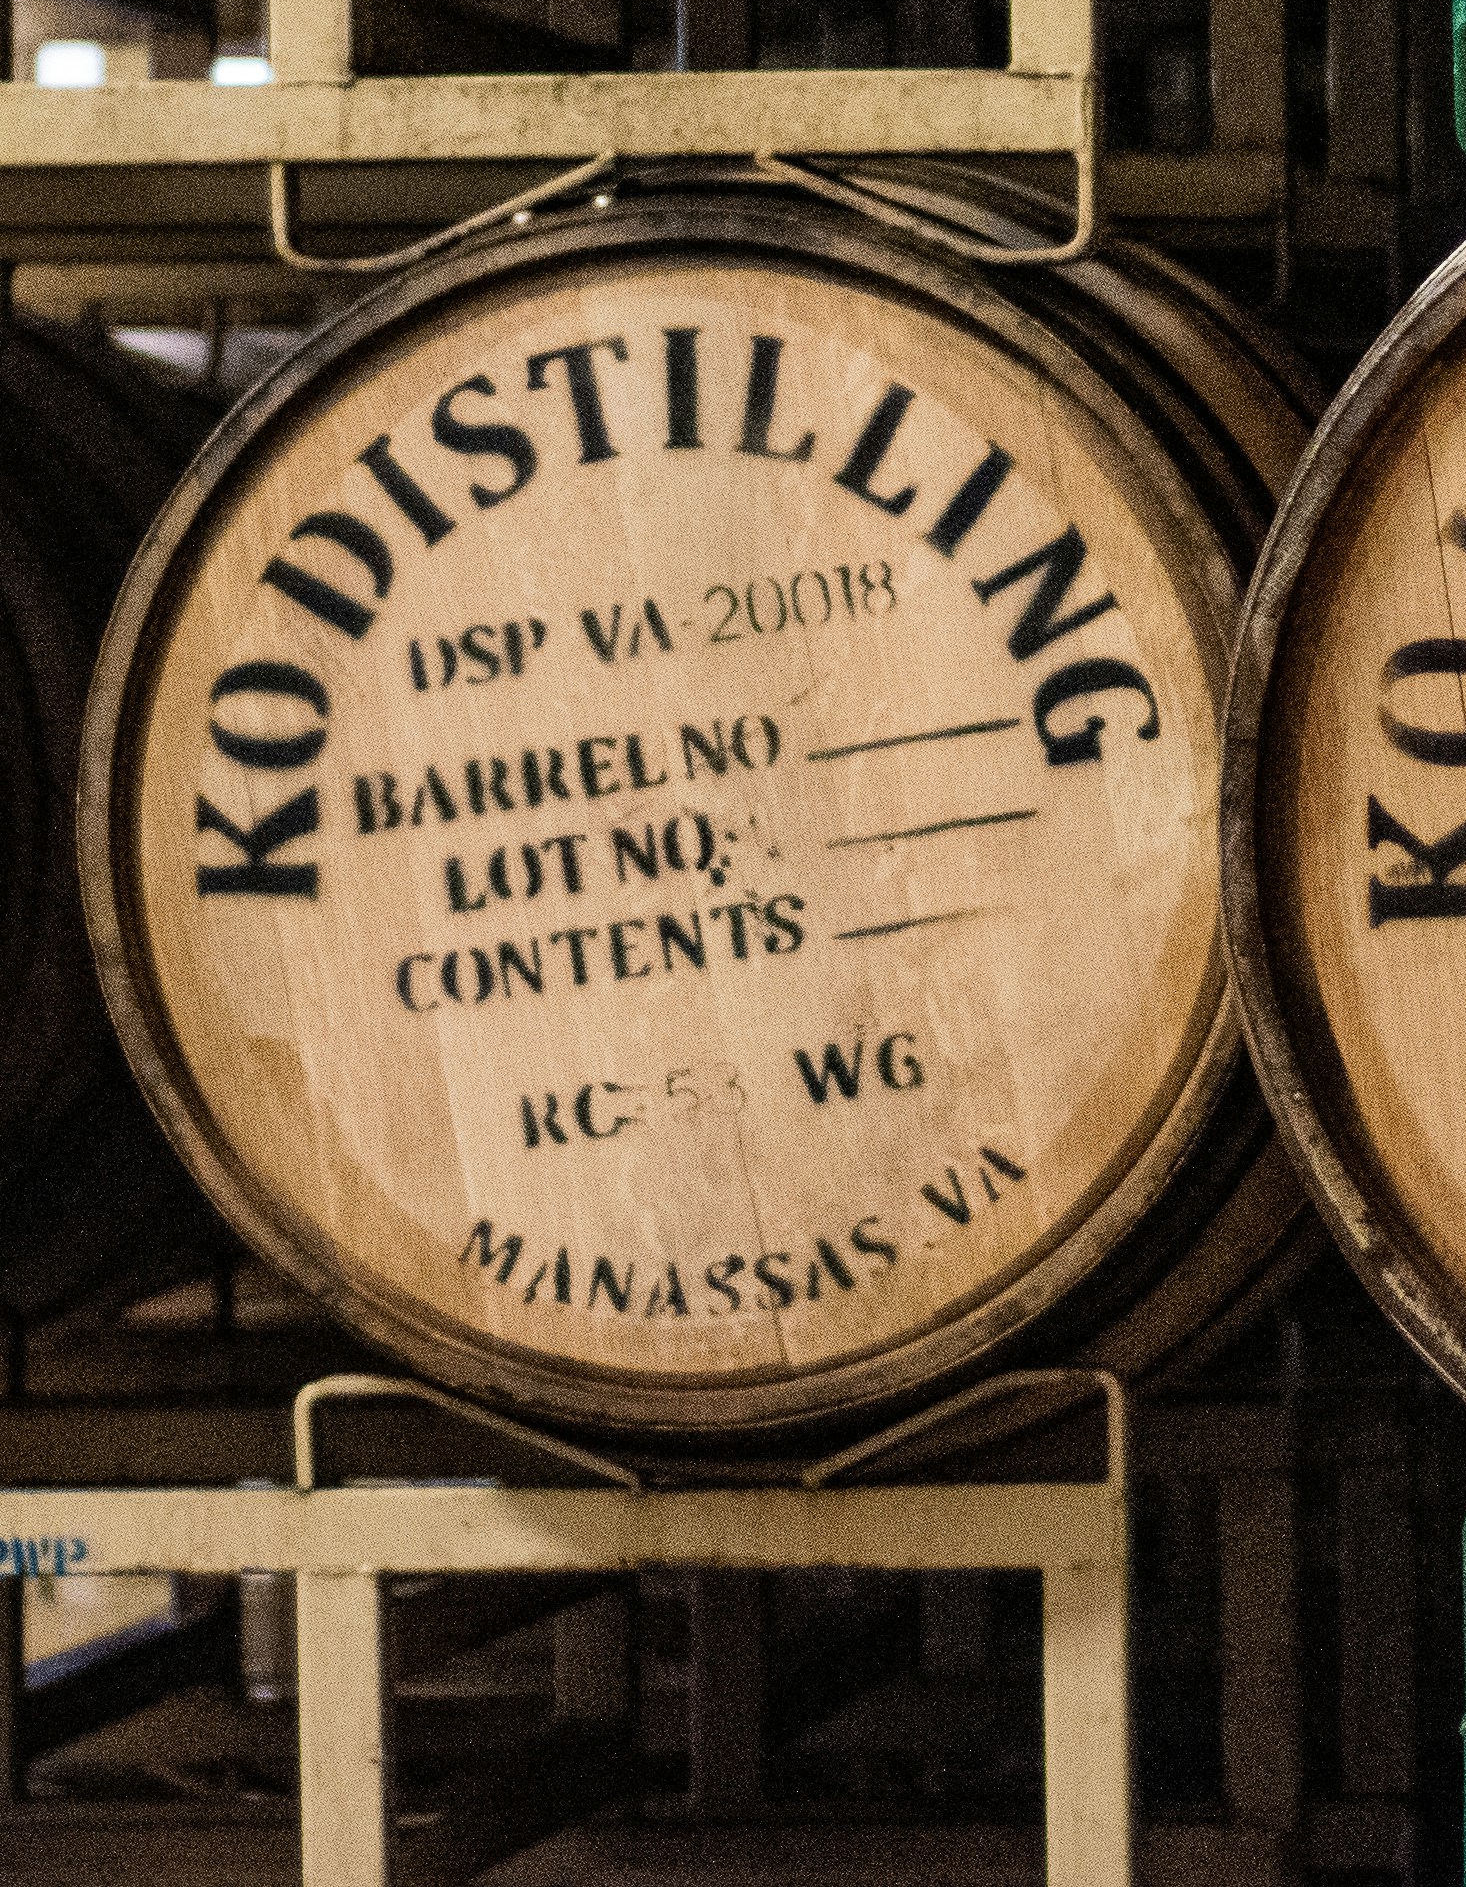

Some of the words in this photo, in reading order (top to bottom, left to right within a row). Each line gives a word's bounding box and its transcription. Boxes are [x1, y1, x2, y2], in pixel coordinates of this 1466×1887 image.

[261, 325, 1162, 770] DISTILLING
[195, 658, 332, 901] KO
[350, 733, 675, 837] BARREL
[678, 711, 782, 783] NO
[443, 834, 588, 917] LOT
[397, 893, 808, 1015] CONTENTS
[792, 1030, 927, 1106] WG
[918, 1143, 1028, 1228] VA
